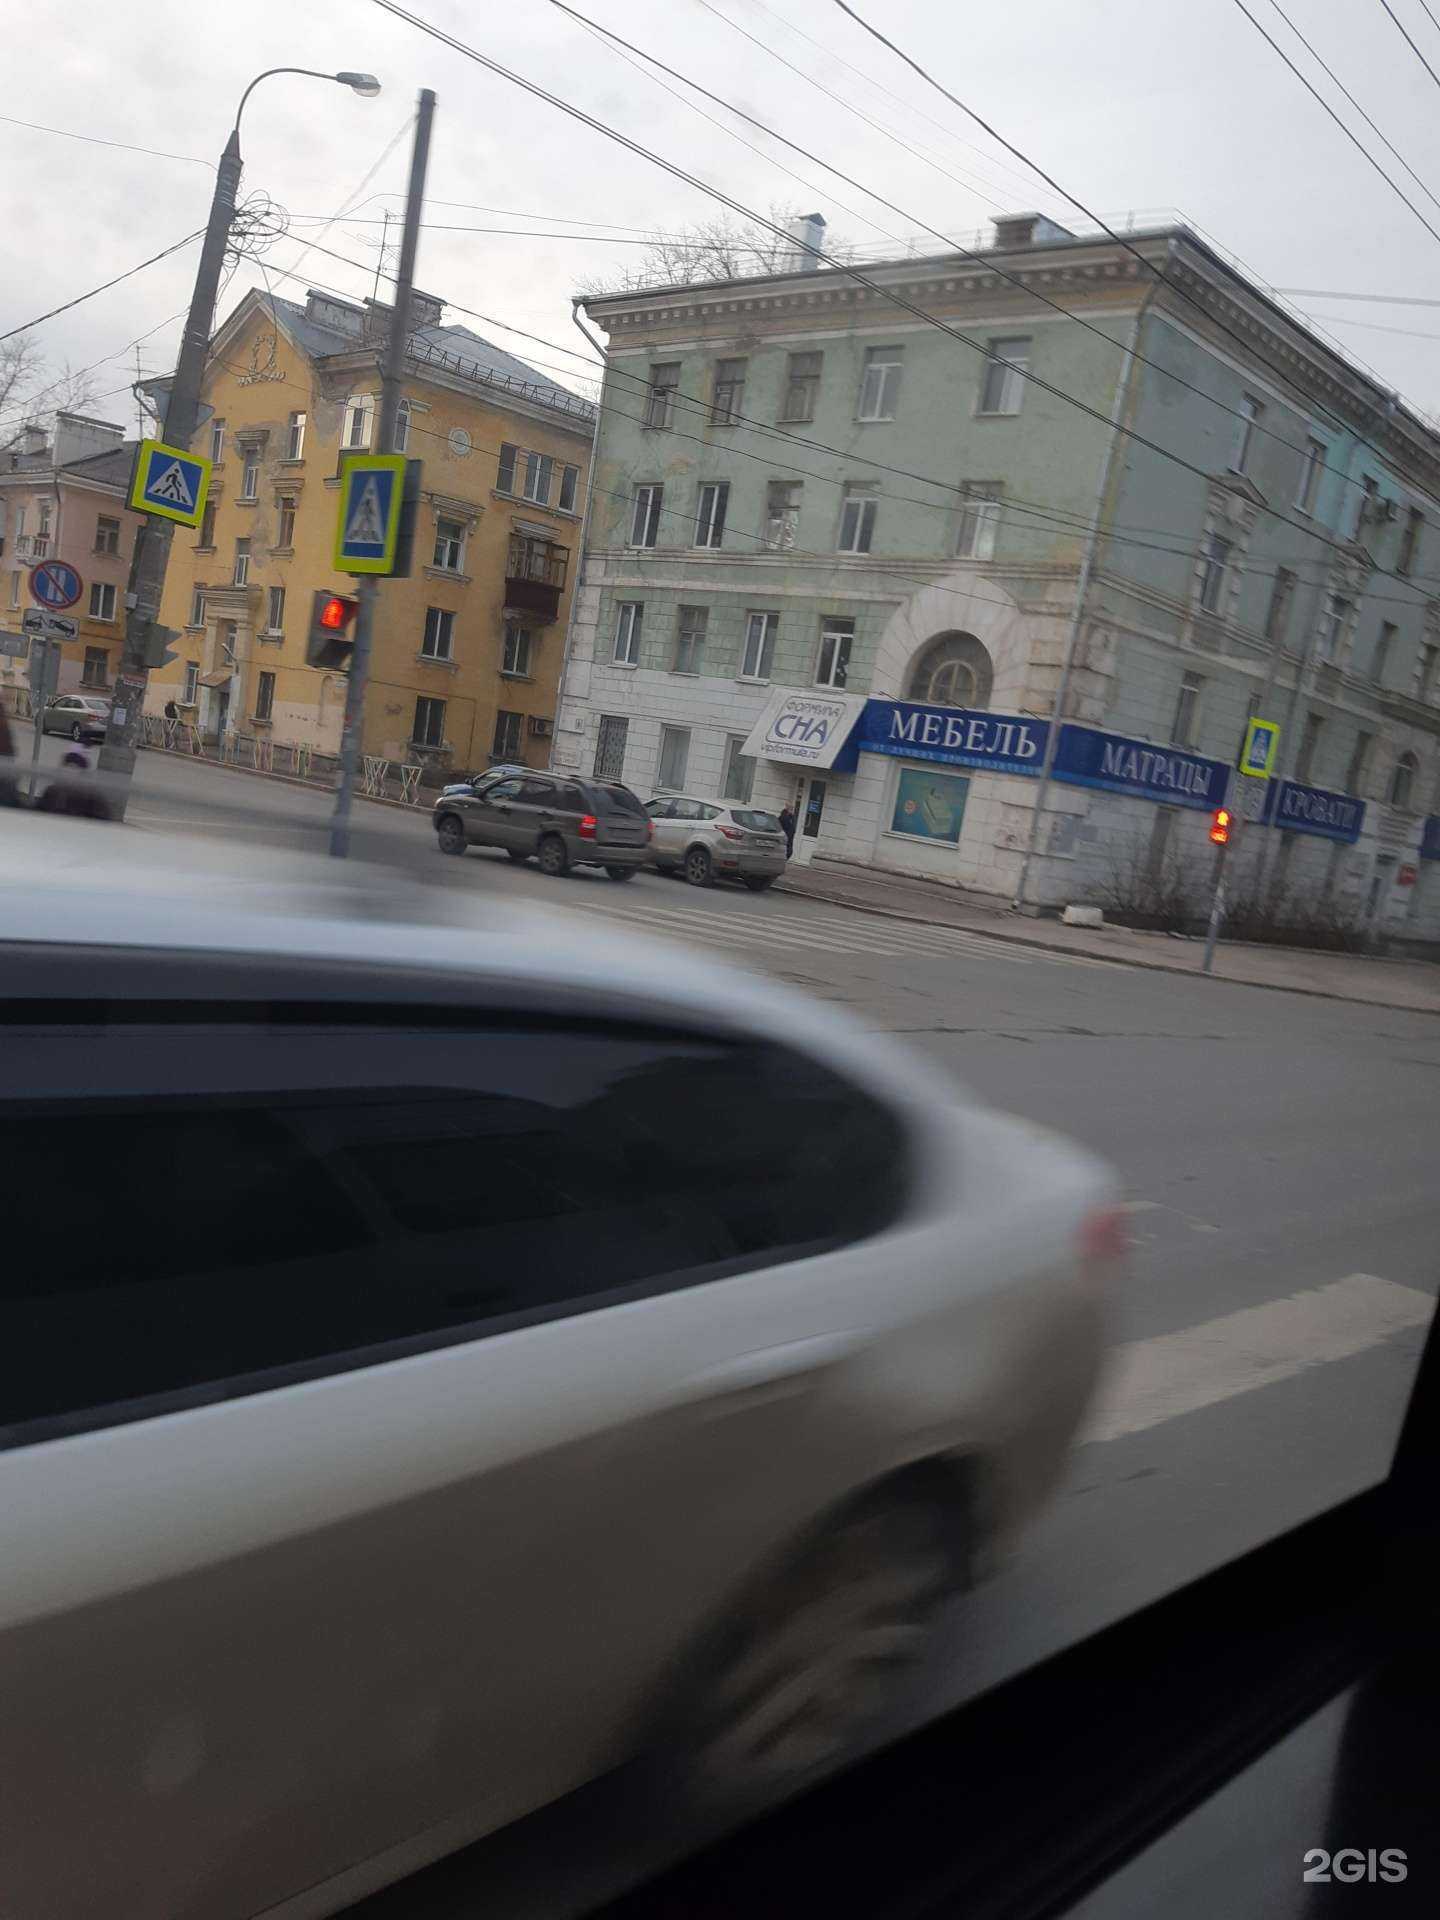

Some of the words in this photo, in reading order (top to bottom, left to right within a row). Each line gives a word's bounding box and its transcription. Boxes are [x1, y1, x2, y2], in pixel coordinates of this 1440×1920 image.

[774, 713, 829, 744] СНА
[786, 701, 840, 718] ФОРМУЛА
[887, 709, 1037, 759] МЕБЕЛЬ
[1100, 742, 1213, 797] МАТРАЦЫ
